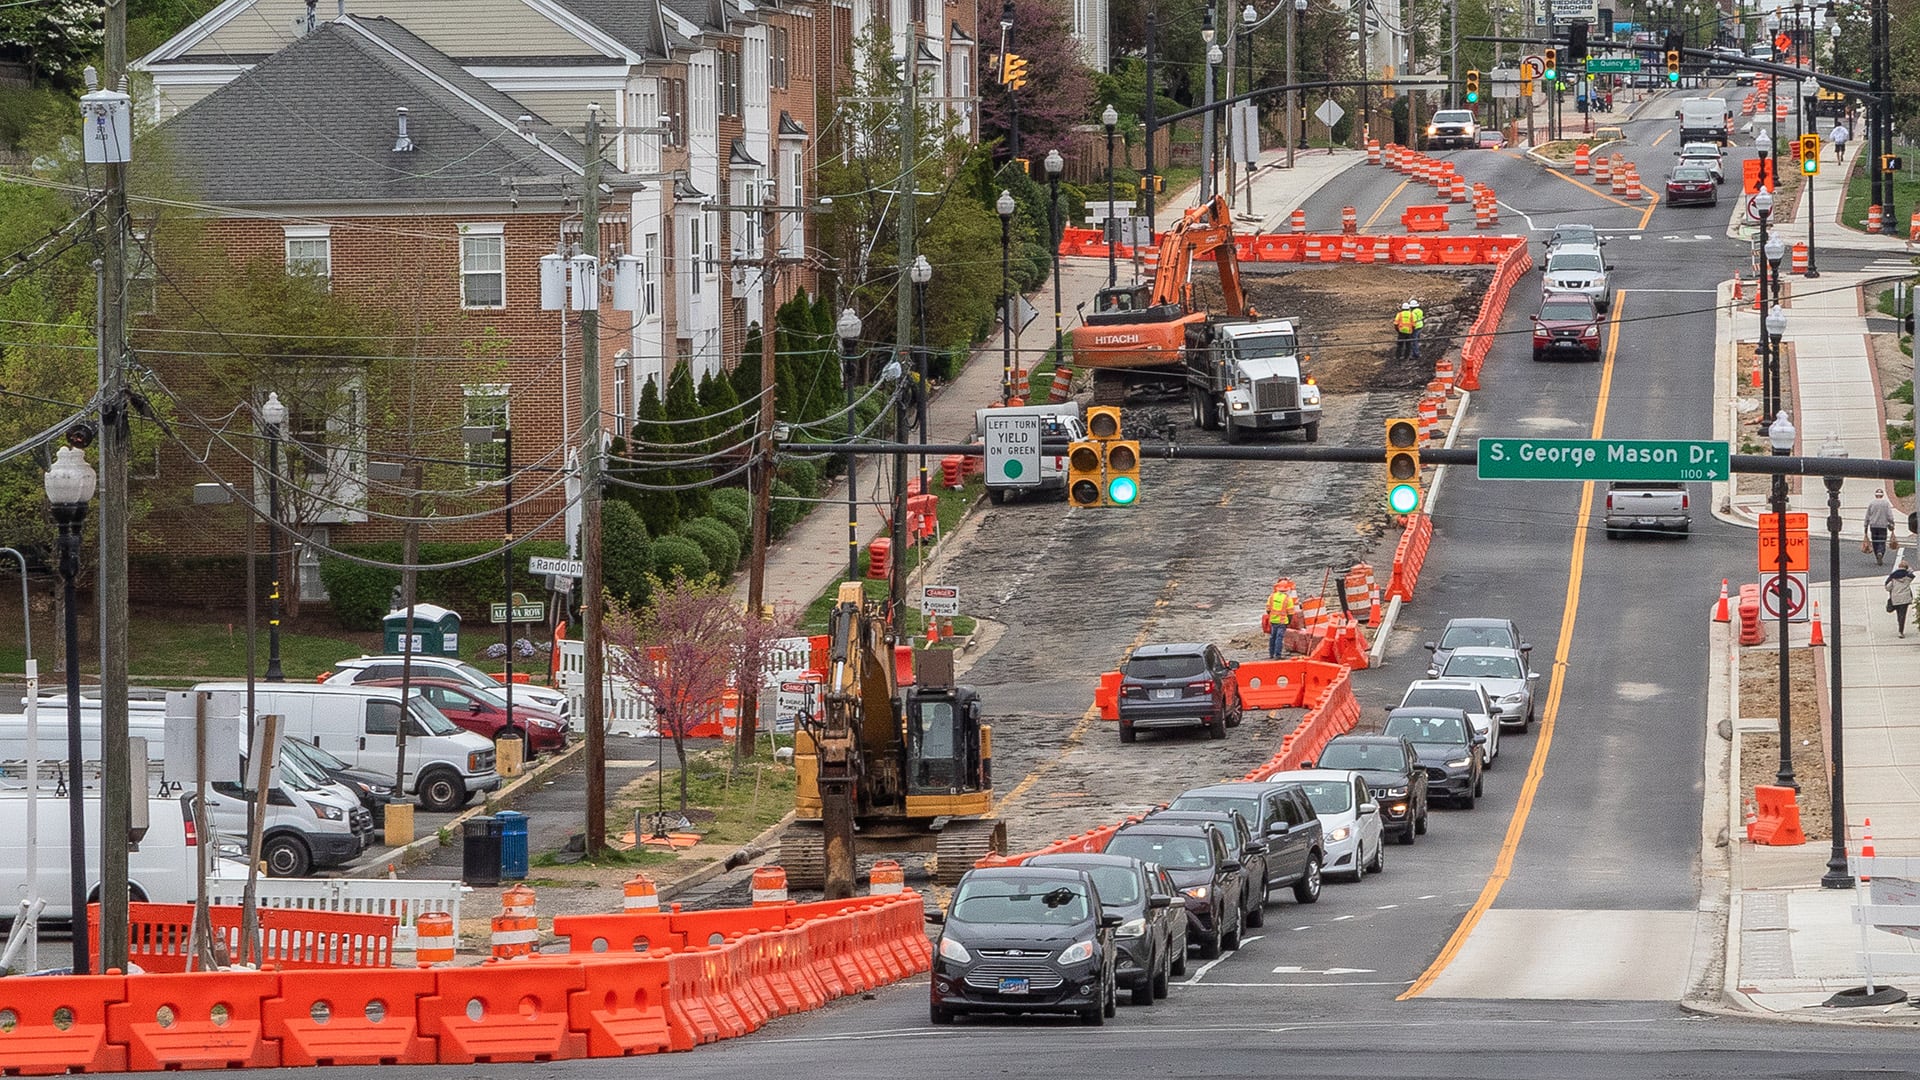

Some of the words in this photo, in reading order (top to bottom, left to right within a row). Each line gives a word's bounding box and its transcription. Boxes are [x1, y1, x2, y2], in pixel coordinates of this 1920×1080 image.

[1600, 60, 1624, 68] Quincy
[1095, 334, 1139, 344] HITACHI
[988, 420, 1009, 430] LEFT
[1015, 420, 1037, 429] TURN
[998, 432, 1028, 443] YIELD
[990, 446, 1002, 455] ON
[1008, 446, 1036, 455] GREEN
[1490, 443, 1511, 461] S.
[1519, 443, 1597, 467] George
[1607, 444, 1678, 463] Mason
[1689, 445, 1718, 464] Dr.
[1681, 469, 1703, 479] 1100
[1762, 537, 1804, 547] DEUR
[537, 559, 583, 574] Randolph
[494, 609, 522, 618] ALCVA
[524, 608, 541, 617] ROW
